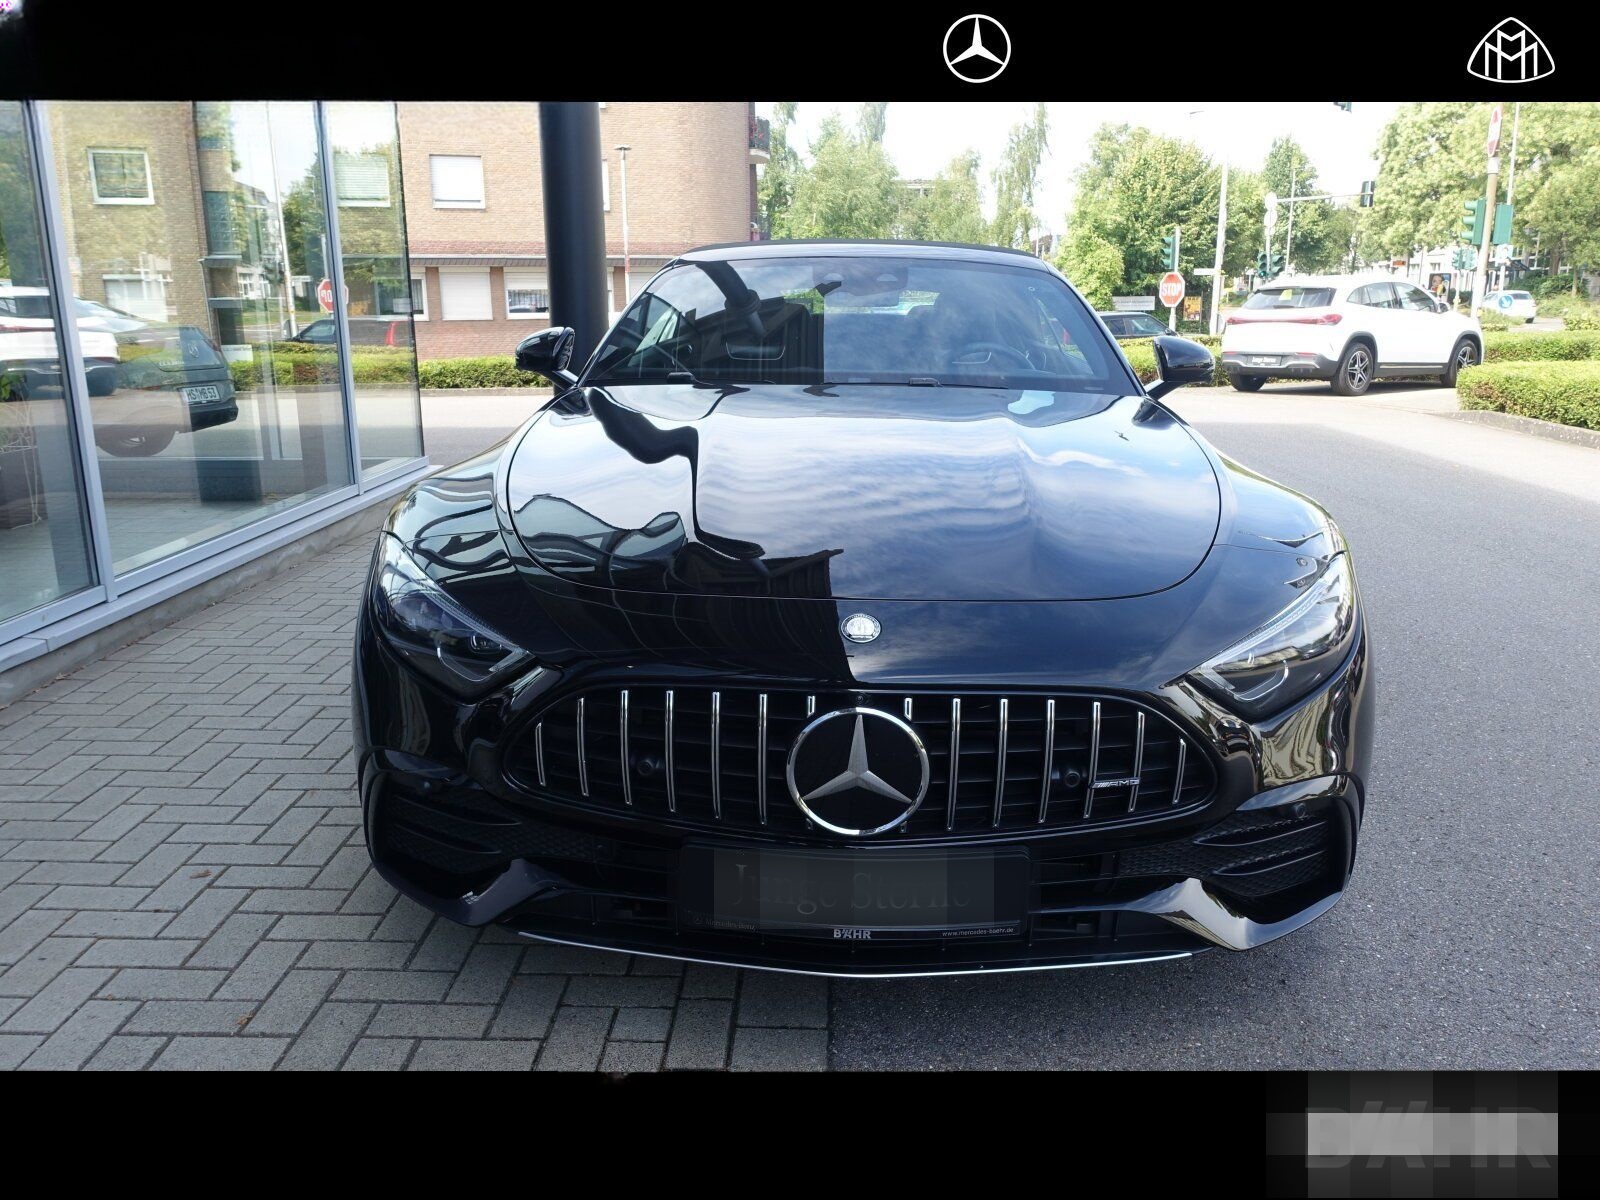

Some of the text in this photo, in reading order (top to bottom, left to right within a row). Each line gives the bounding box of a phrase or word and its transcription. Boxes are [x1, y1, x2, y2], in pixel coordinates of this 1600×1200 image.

[1162, 283, 1182, 297] STOP
[733, 863, 972, 915] Junge Sterne
[942, 927, 1014, 937] www.mercedes-baehr.de
